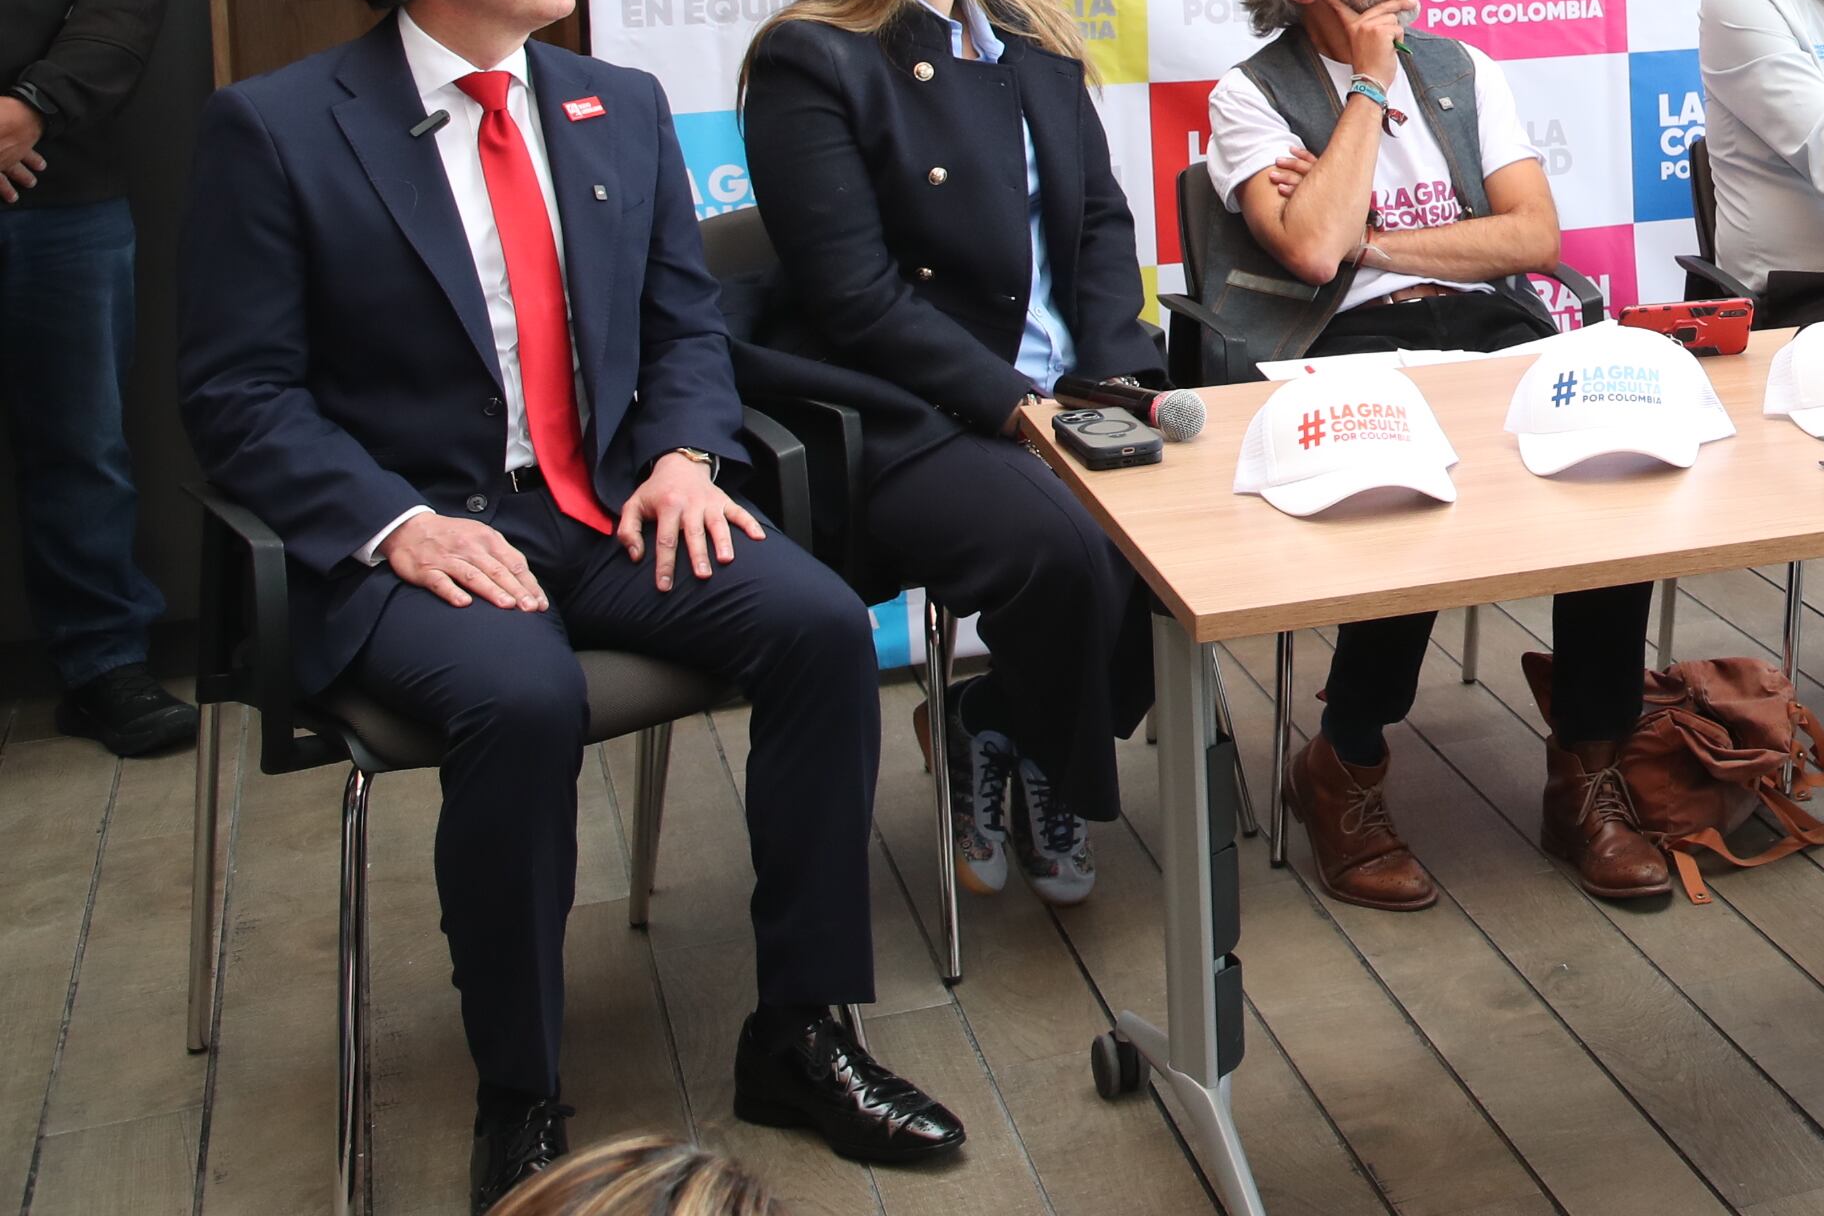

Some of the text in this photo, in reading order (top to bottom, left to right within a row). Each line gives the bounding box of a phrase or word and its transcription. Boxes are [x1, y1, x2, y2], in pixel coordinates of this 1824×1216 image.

[1428, 0, 1603, 29] POR COLOMBIA
[1658, 91, 1706, 127] LA
[1583, 366, 1660, 382] LA GRAN
[1582, 380, 1661, 394] CONSULTA
[1582, 393, 1662, 405] POR COLOMBIA
[1330, 403, 1407, 421] LA GRAN
[1331, 417, 1410, 433] CONSULTA
[1333, 432, 1358, 443] POR
